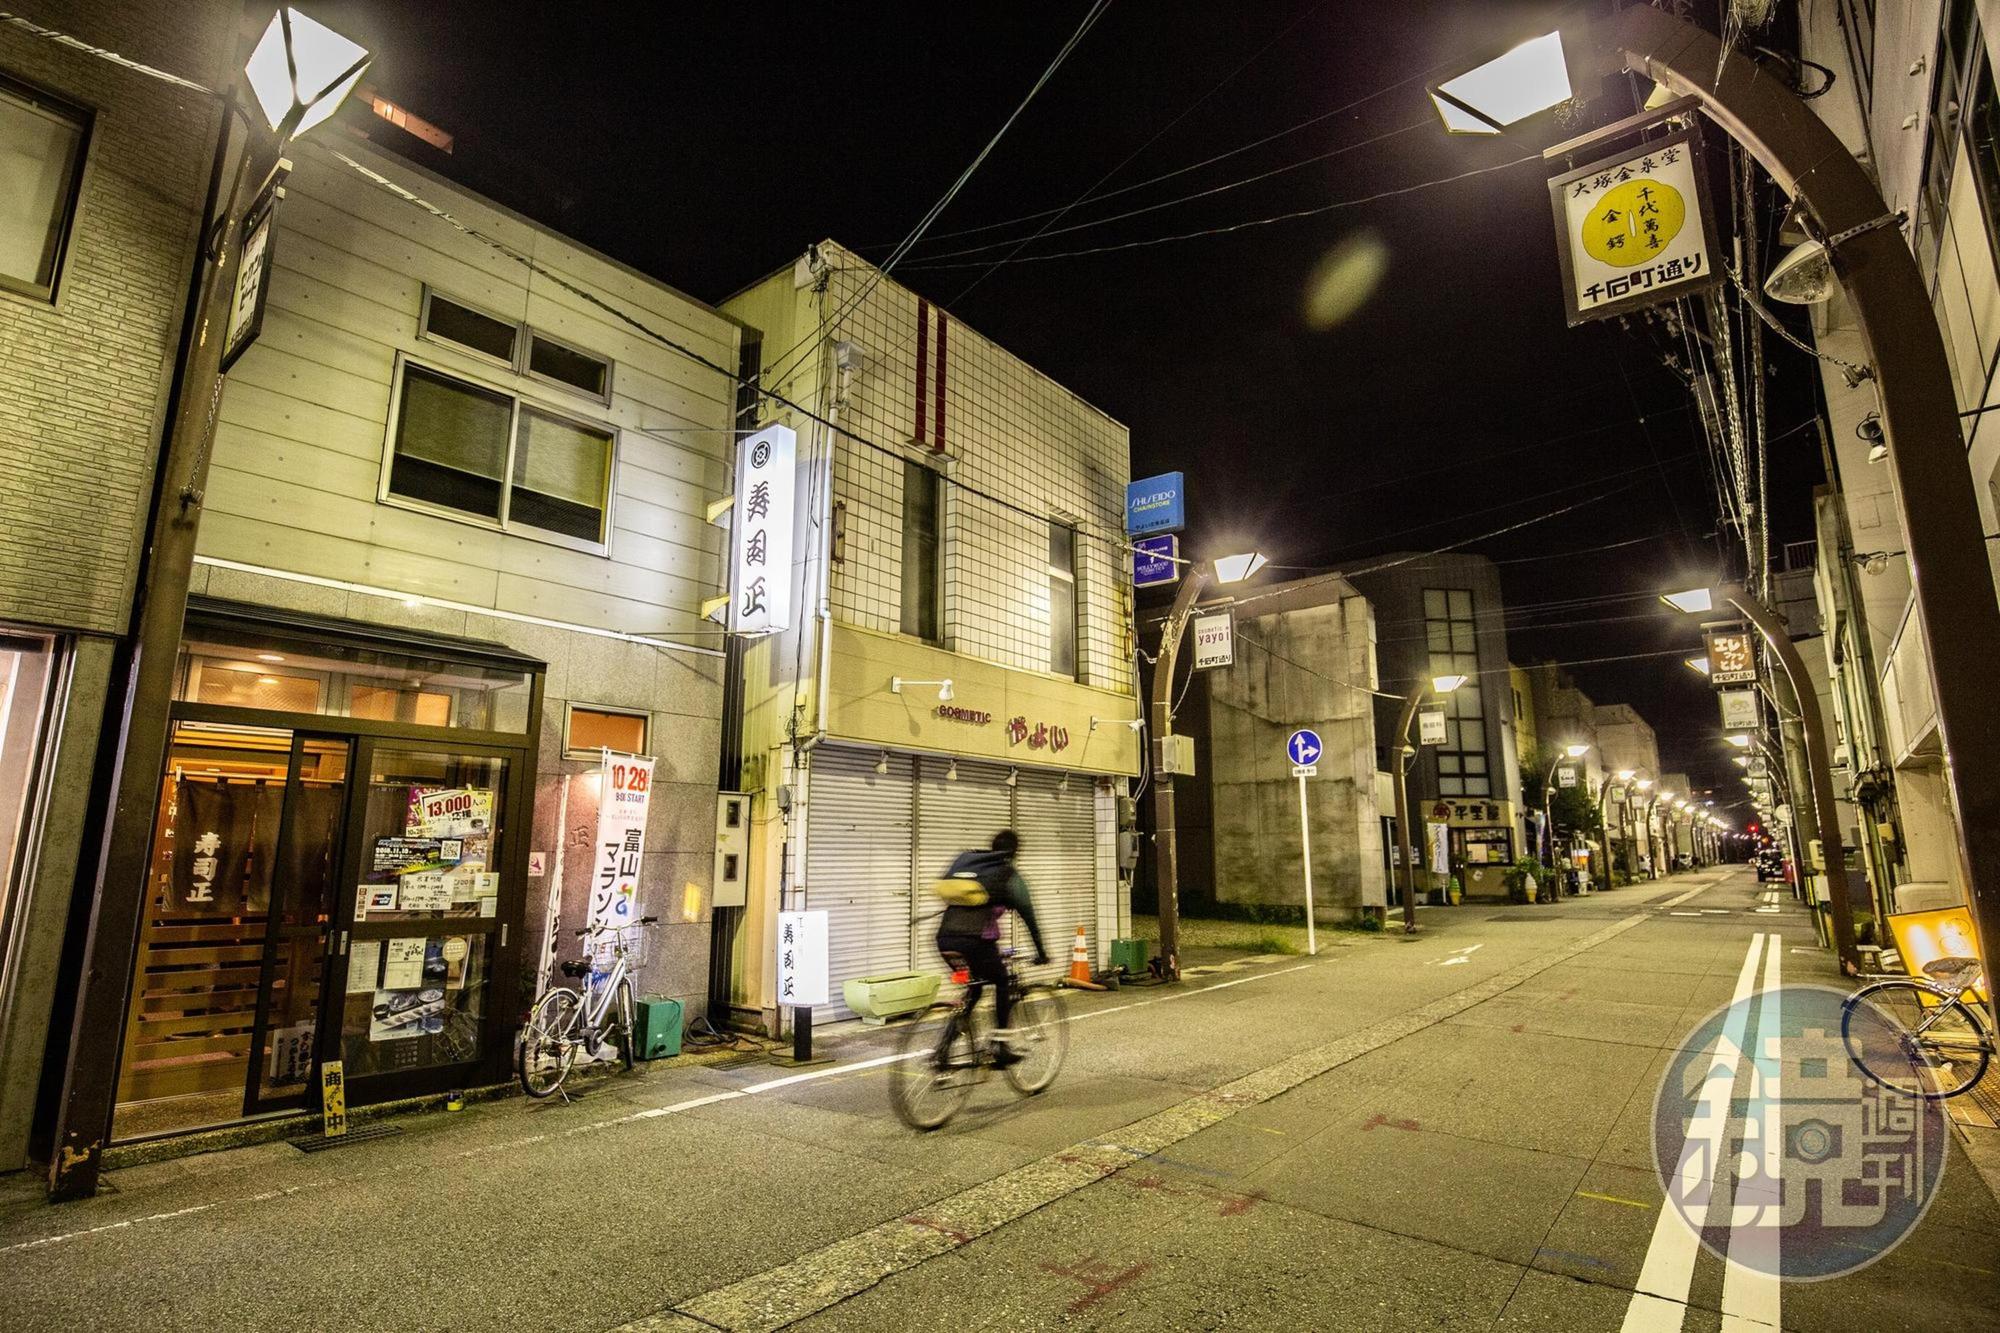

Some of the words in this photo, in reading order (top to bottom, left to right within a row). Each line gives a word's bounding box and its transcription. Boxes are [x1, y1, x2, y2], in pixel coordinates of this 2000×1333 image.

[1572, 148, 1681, 199] 大塚金泉堂
[1636, 186, 1664, 250] 千代萬喜
[1583, 252, 1702, 303] 千石町通り
[1129, 489, 1177, 510] SHISEIDO
[1133, 500, 1171, 514] CHAINSTORE
[1198, 631, 1230, 647] yayoi
[1008, 715, 1069, 753] やよい
[611, 764, 625, 790] 10
[628, 766, 647, 792] 28
[627, 792, 645, 803] START
[186, 831, 222, 903] 寿司正
[619, 828, 642, 877] 富山
[593, 842, 621, 938] マラソン
